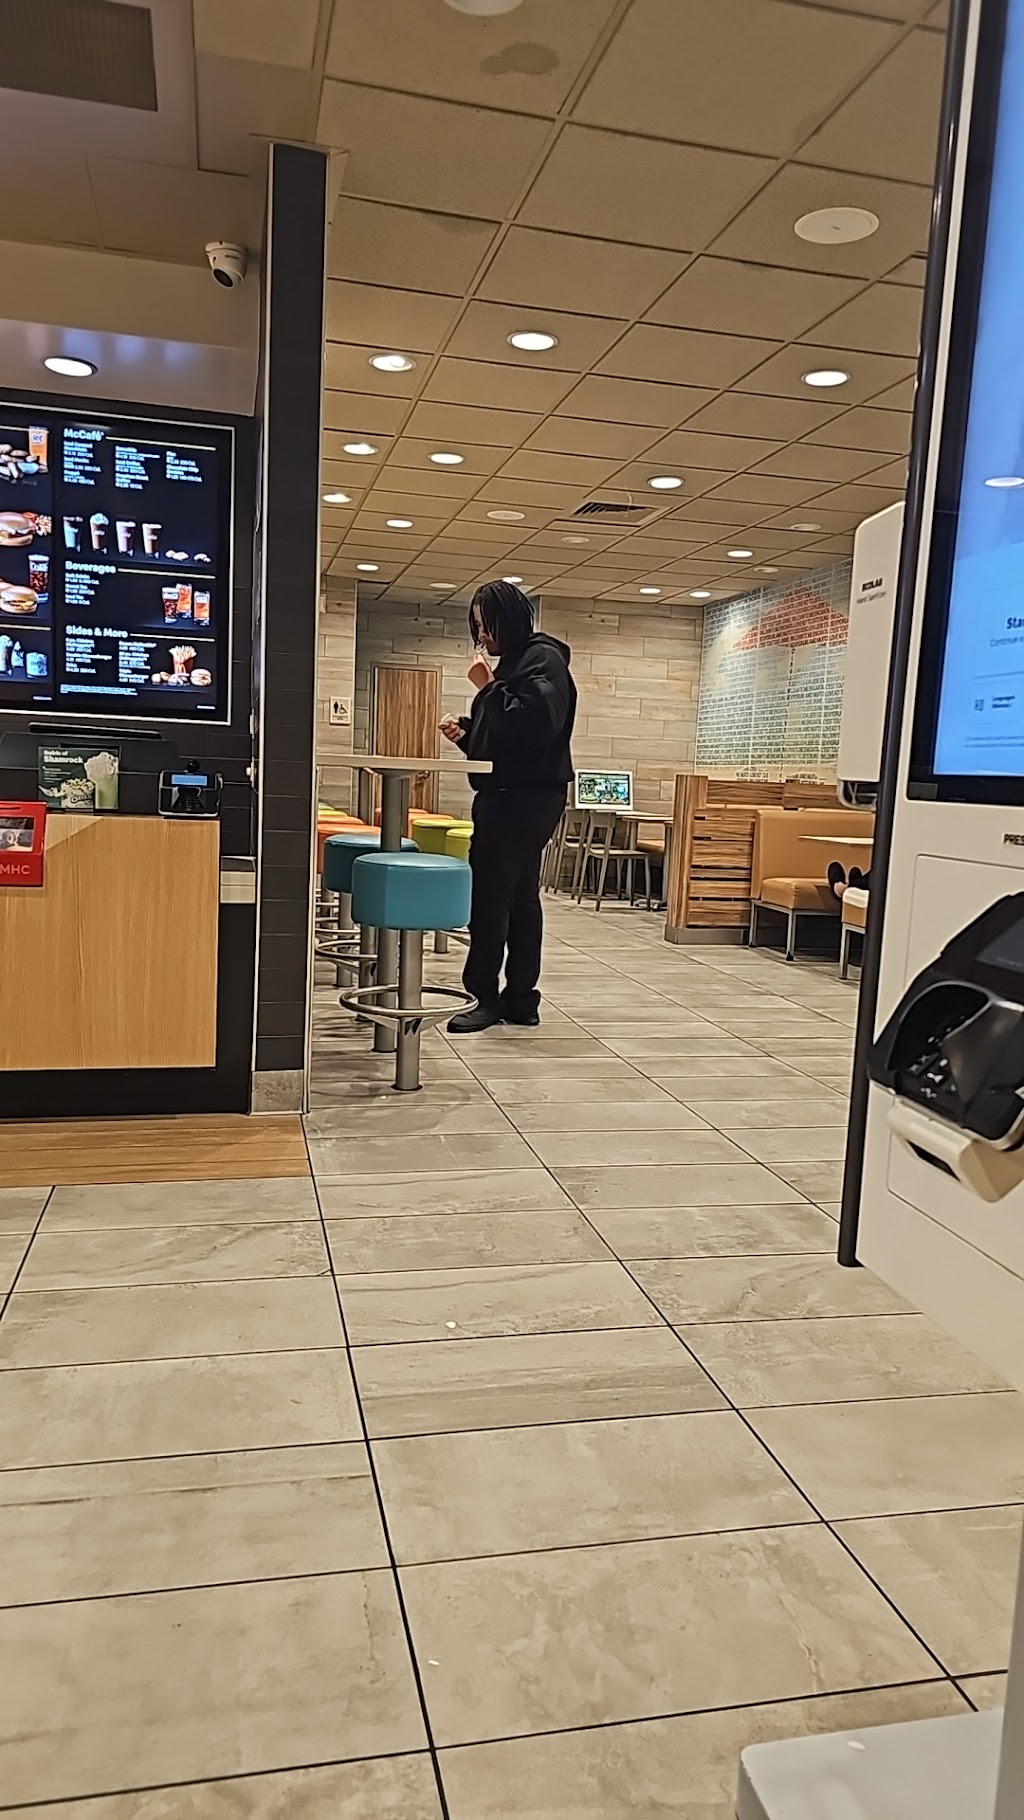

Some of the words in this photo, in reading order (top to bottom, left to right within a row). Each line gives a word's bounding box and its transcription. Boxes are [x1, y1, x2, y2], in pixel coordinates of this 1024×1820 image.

[65, 560, 116, 575] Beverages
[65, 625, 93, 636] Sides
[94, 628, 102, 636] &
[103, 629, 128, 639] More
[43, 755, 84, 764] Shamrock
